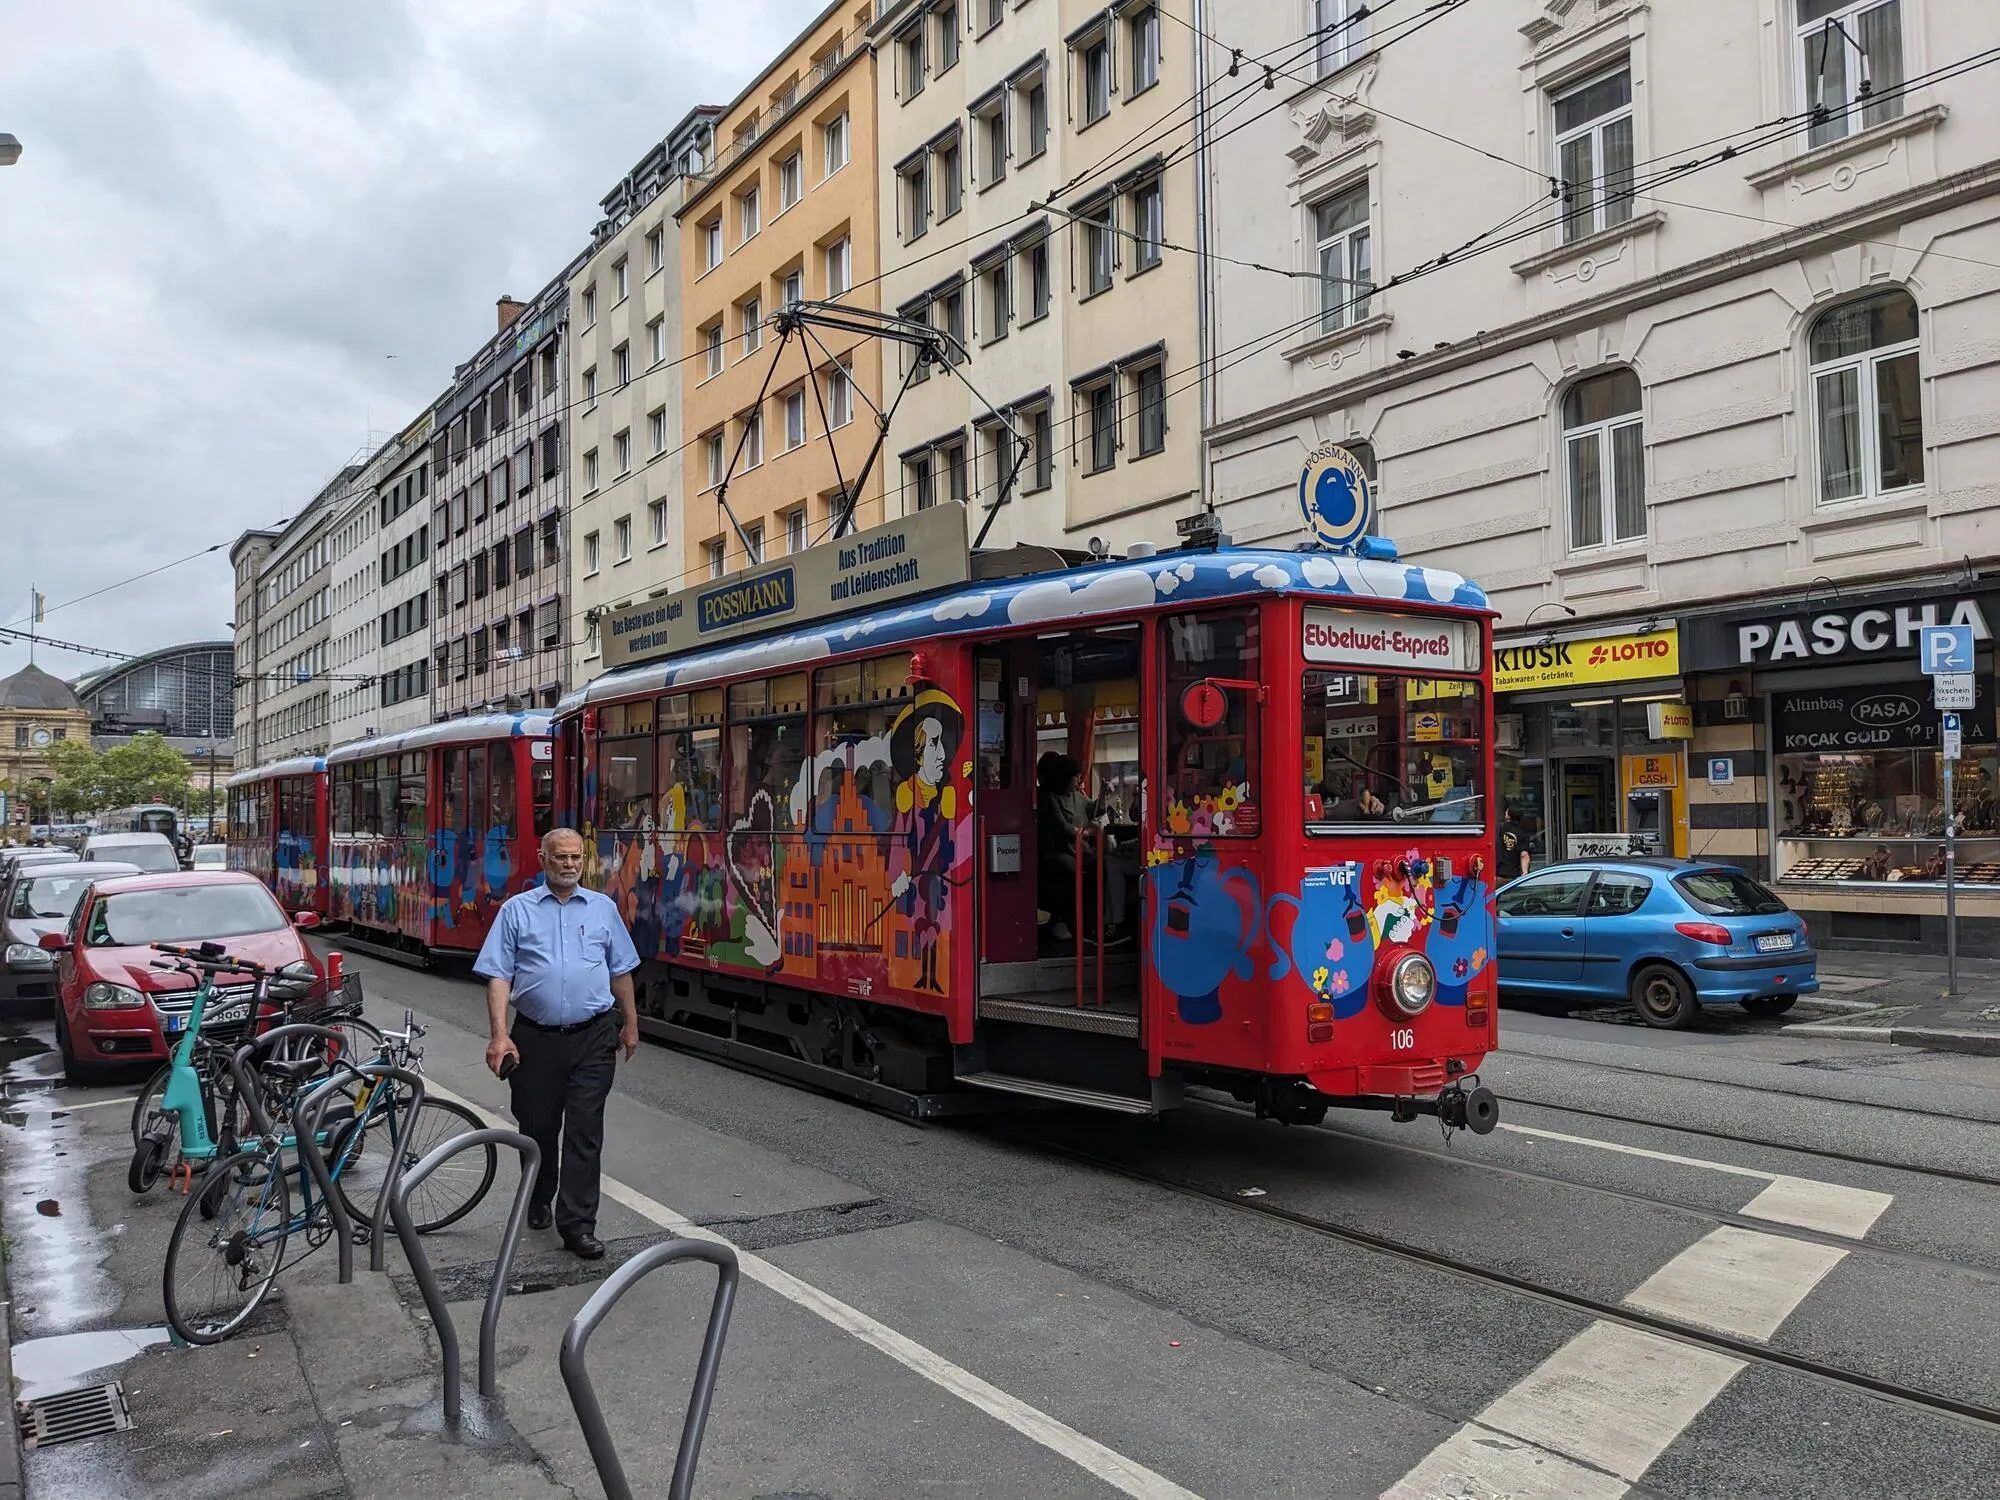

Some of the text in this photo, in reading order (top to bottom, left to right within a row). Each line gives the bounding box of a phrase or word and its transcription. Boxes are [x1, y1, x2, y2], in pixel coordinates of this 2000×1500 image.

[1305, 447, 1364, 479] POSSMANN
[838, 533, 906, 571] Aus Tradition
[830, 558, 920, 602] und Leidenschaft
[705, 576, 787, 625] POSSMANN
[612, 599, 683, 636] Das Beste was ein Apfel
[629, 630, 668, 653] werden kann
[1304, 623, 1450, 660] Ebbelwei-Expreß
[1738, 598, 1994, 664] PASCHA
[1495, 641, 1573, 673] KIOSK
[1611, 639, 1670, 662] LOTTO
[1930, 632, 1958, 668] P
[1495, 671, 1574, 686] Tabakwaren Getränke
[1943, 678, 1955, 686] mit
[1671, 715, 1690, 726] LOTTO
[1859, 702, 1911, 721] PAŞA
[1785, 729, 1891, 749] KOÇAK GOLD
[1639, 774, 1668, 785] CASH
[1309, 799, 1316, 812] 1
[996, 846, 1018, 856] Papier
[1329, 871, 1356, 886] VGF
[708, 954, 719, 969] 106
[1389, 1029, 1414, 1050] 106
[196, 1114, 205, 1140] TIER
